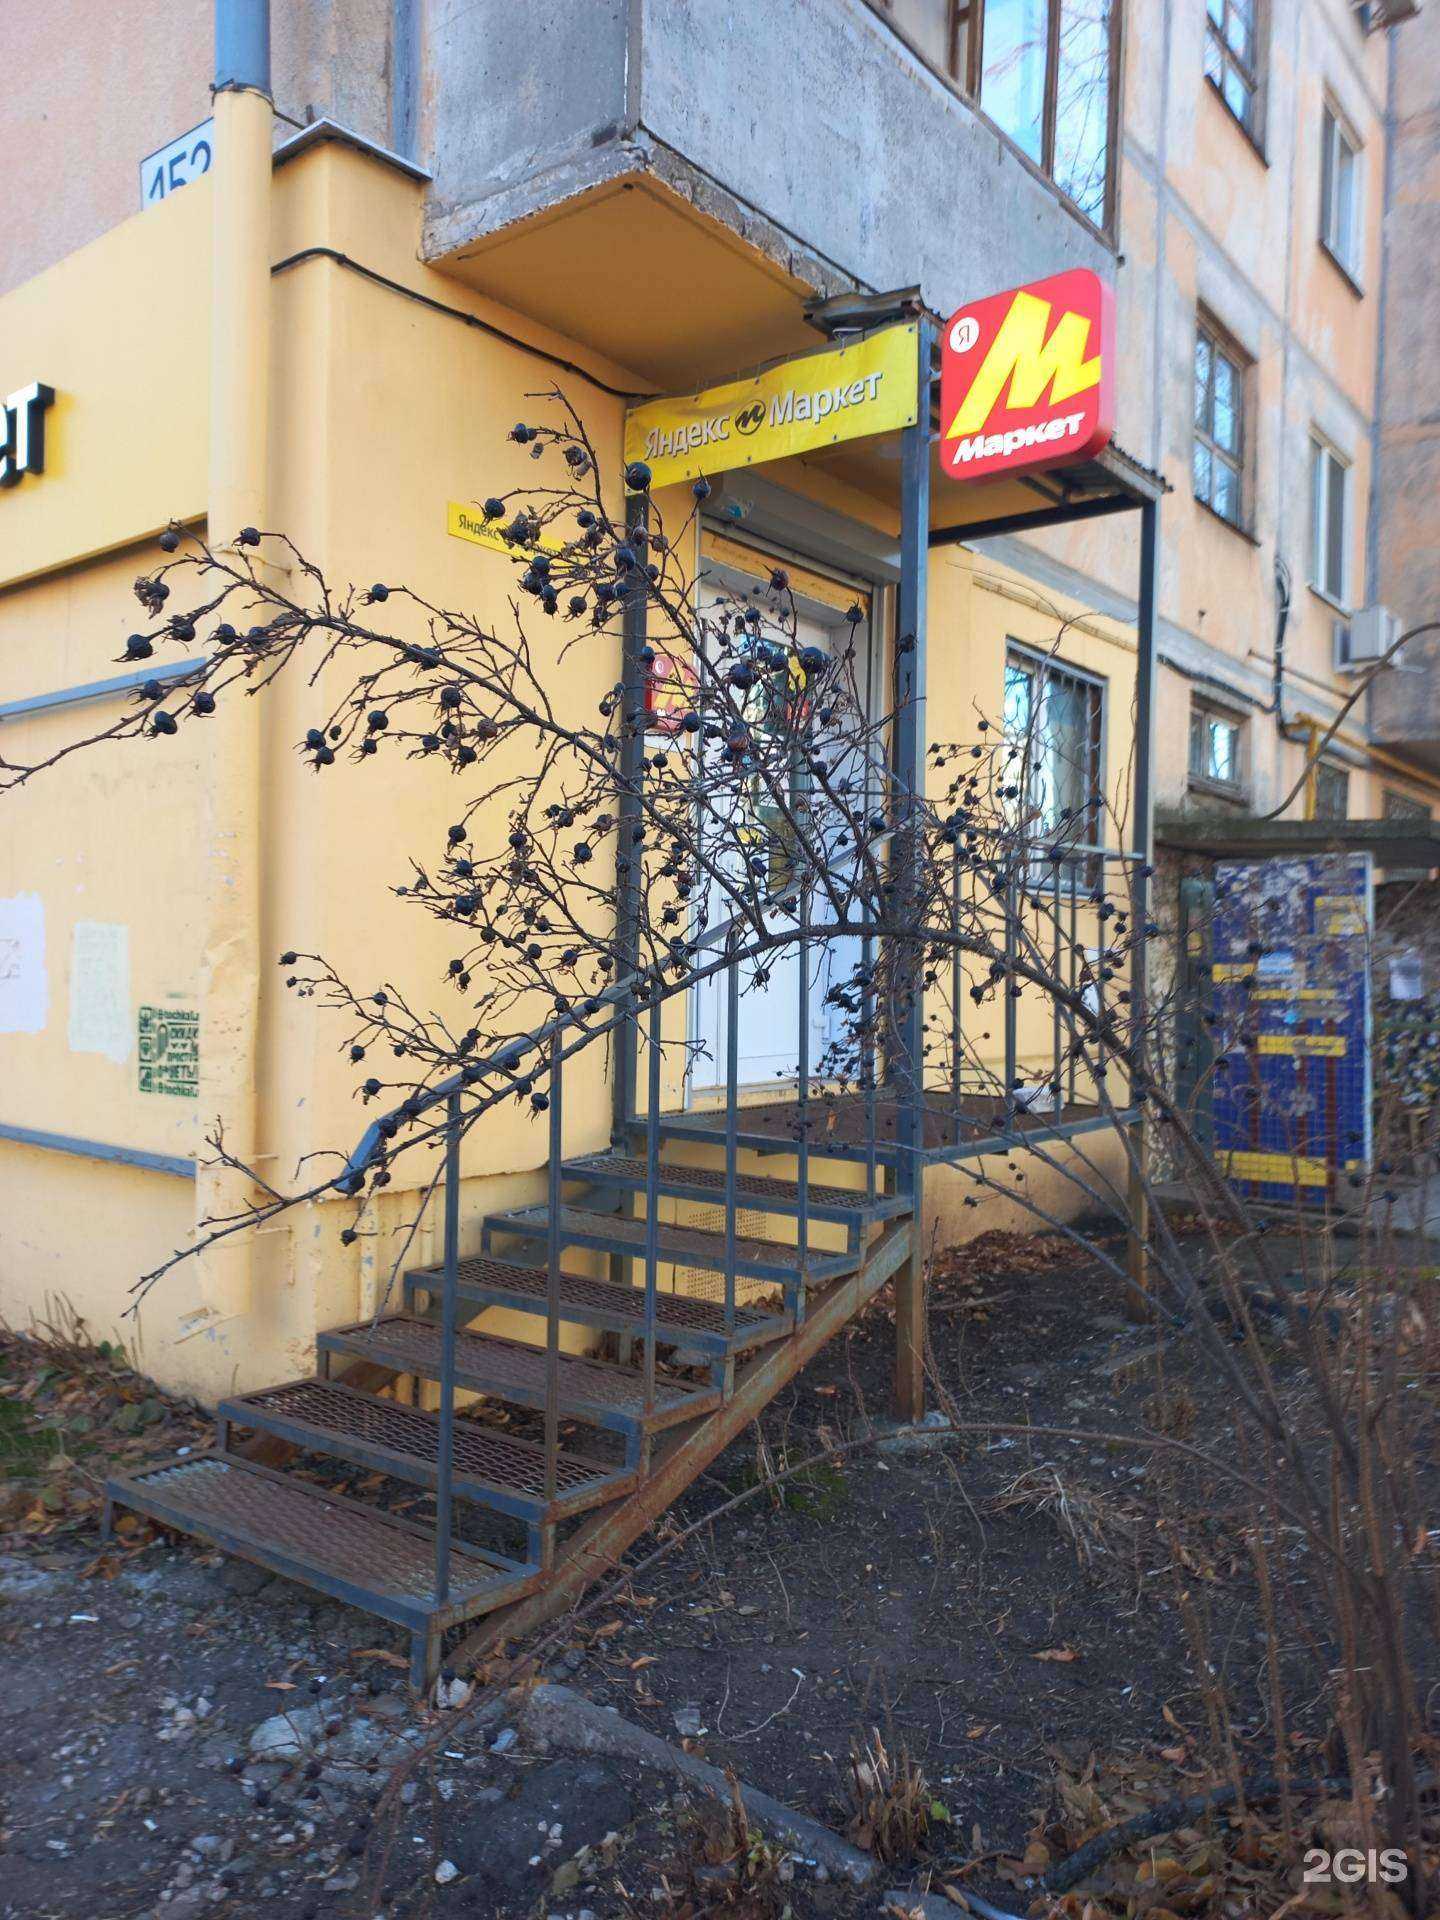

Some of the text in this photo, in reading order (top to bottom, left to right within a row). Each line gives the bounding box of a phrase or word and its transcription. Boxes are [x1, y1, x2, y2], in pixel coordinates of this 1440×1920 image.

[643, 415, 731, 461] Яндекс
[769, 371, 884, 428] Маркет
[952, 411, 1087, 466] Маркет
[458, 513, 500, 541] Яндекс
